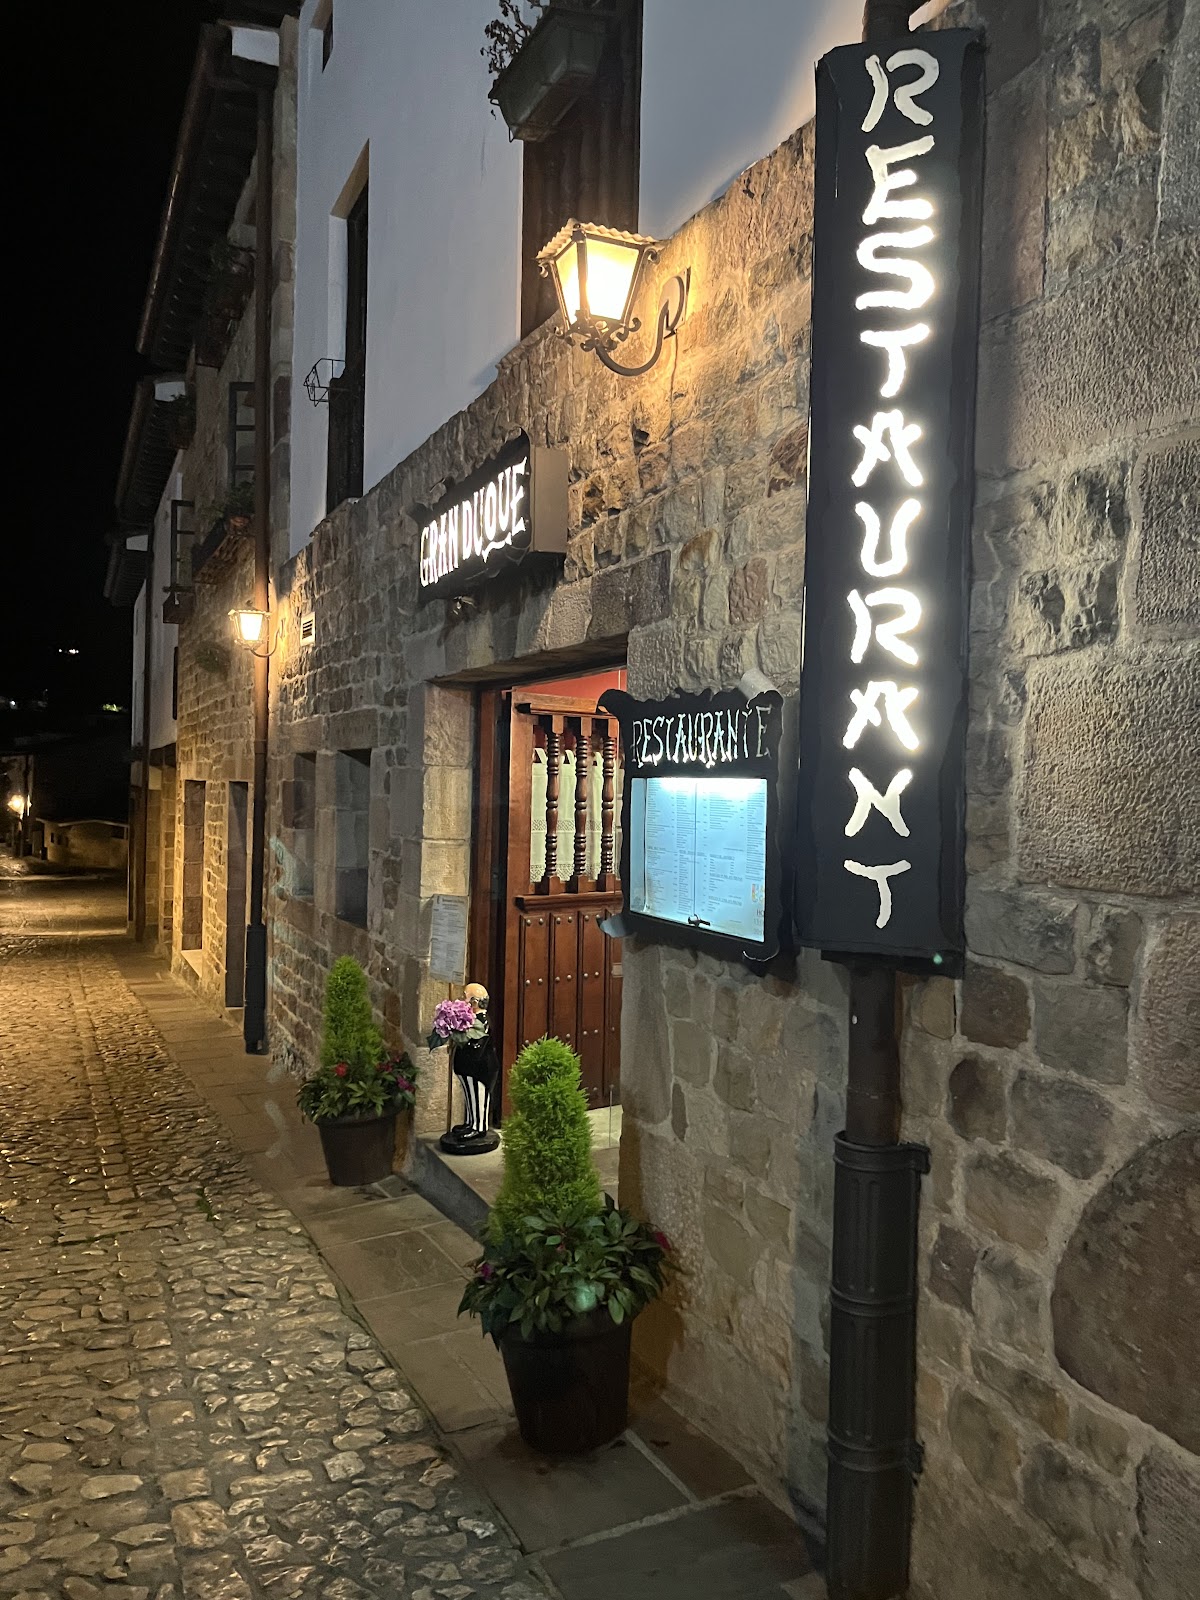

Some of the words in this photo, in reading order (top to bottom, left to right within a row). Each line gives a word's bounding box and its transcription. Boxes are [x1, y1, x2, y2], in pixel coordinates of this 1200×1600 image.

[419, 503, 460, 588] GRAN
[461, 456, 528, 563] DUQUE
[843, 47, 941, 929] RESTAURANT
[630, 704, 773, 769] RESTAURANTE
